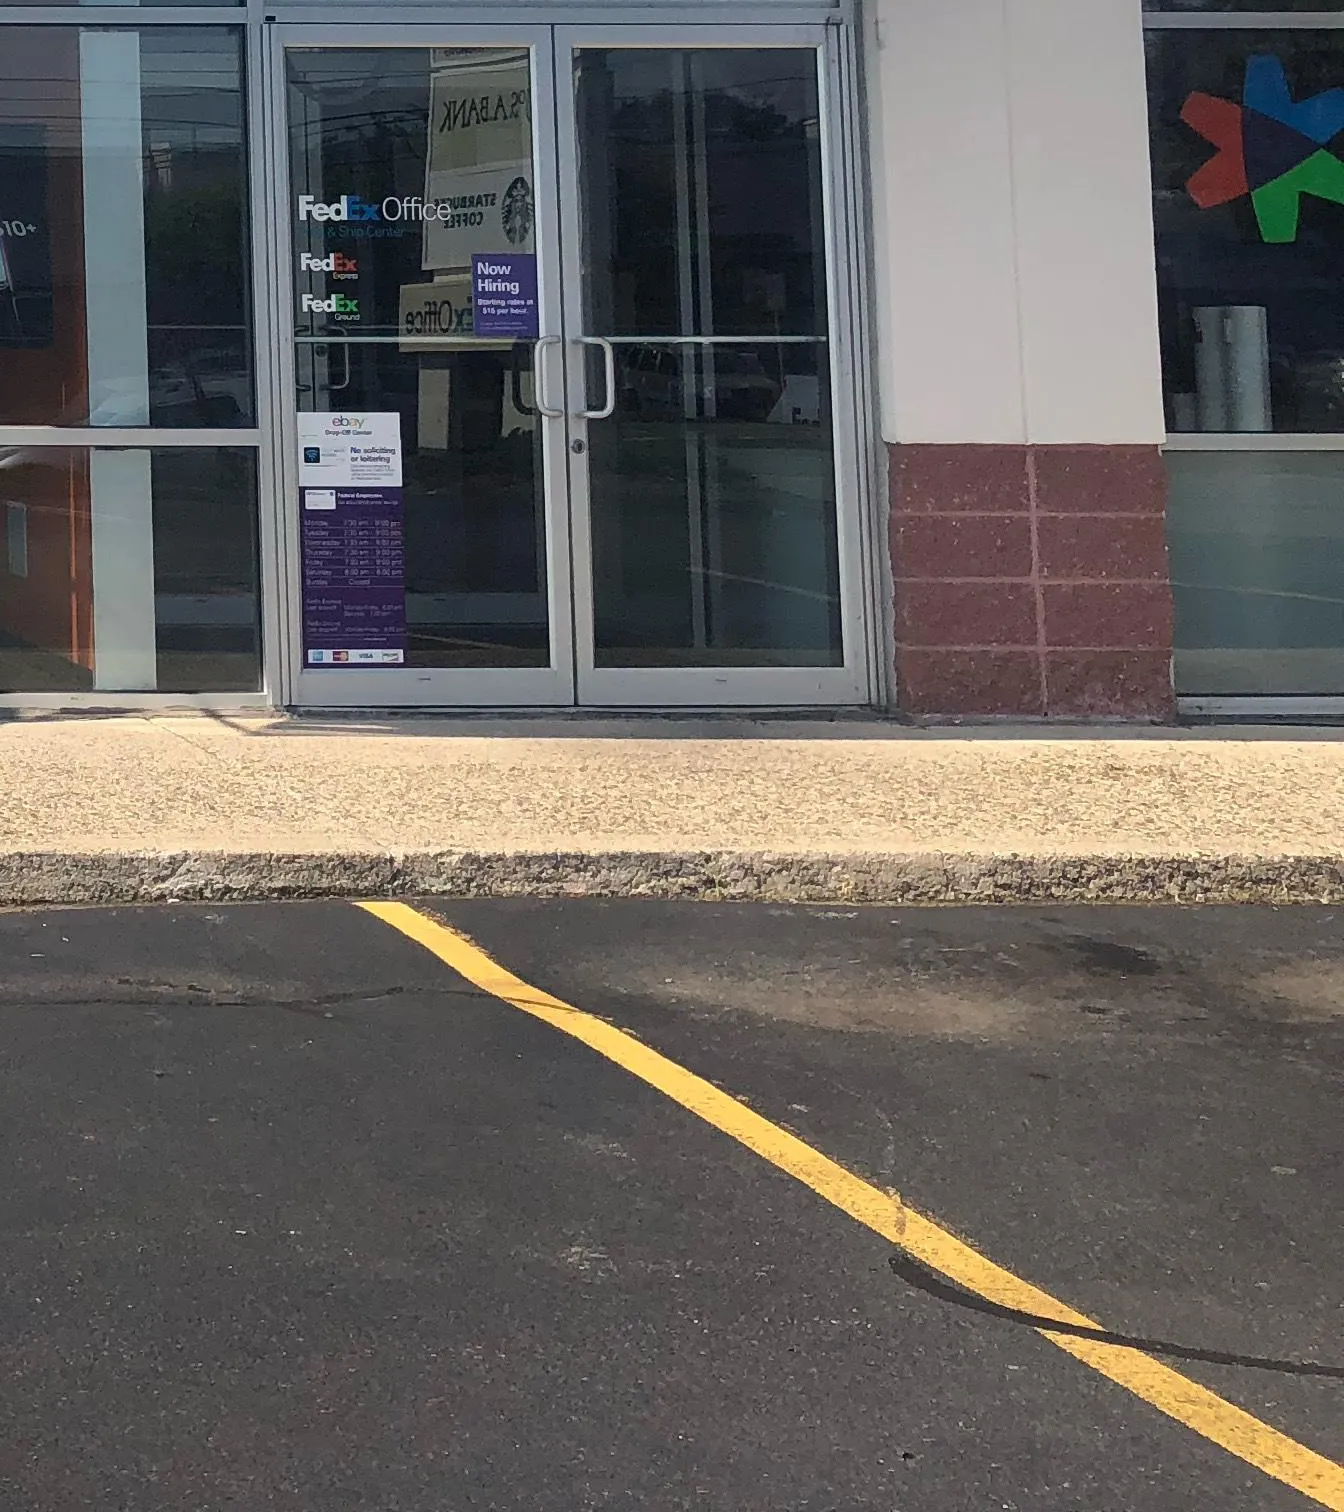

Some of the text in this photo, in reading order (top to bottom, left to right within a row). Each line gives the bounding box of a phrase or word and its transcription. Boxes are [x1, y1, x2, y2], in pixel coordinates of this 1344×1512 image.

[298, 195, 452, 222] FedEx Office
[300, 253, 358, 272] FedEx
[477, 262, 512, 275] Now
[477, 279, 520, 295] Hiring
[302, 294, 359, 313] FedEx
[334, 313, 361, 321] Ground
[332, 416, 366, 429] ebay
